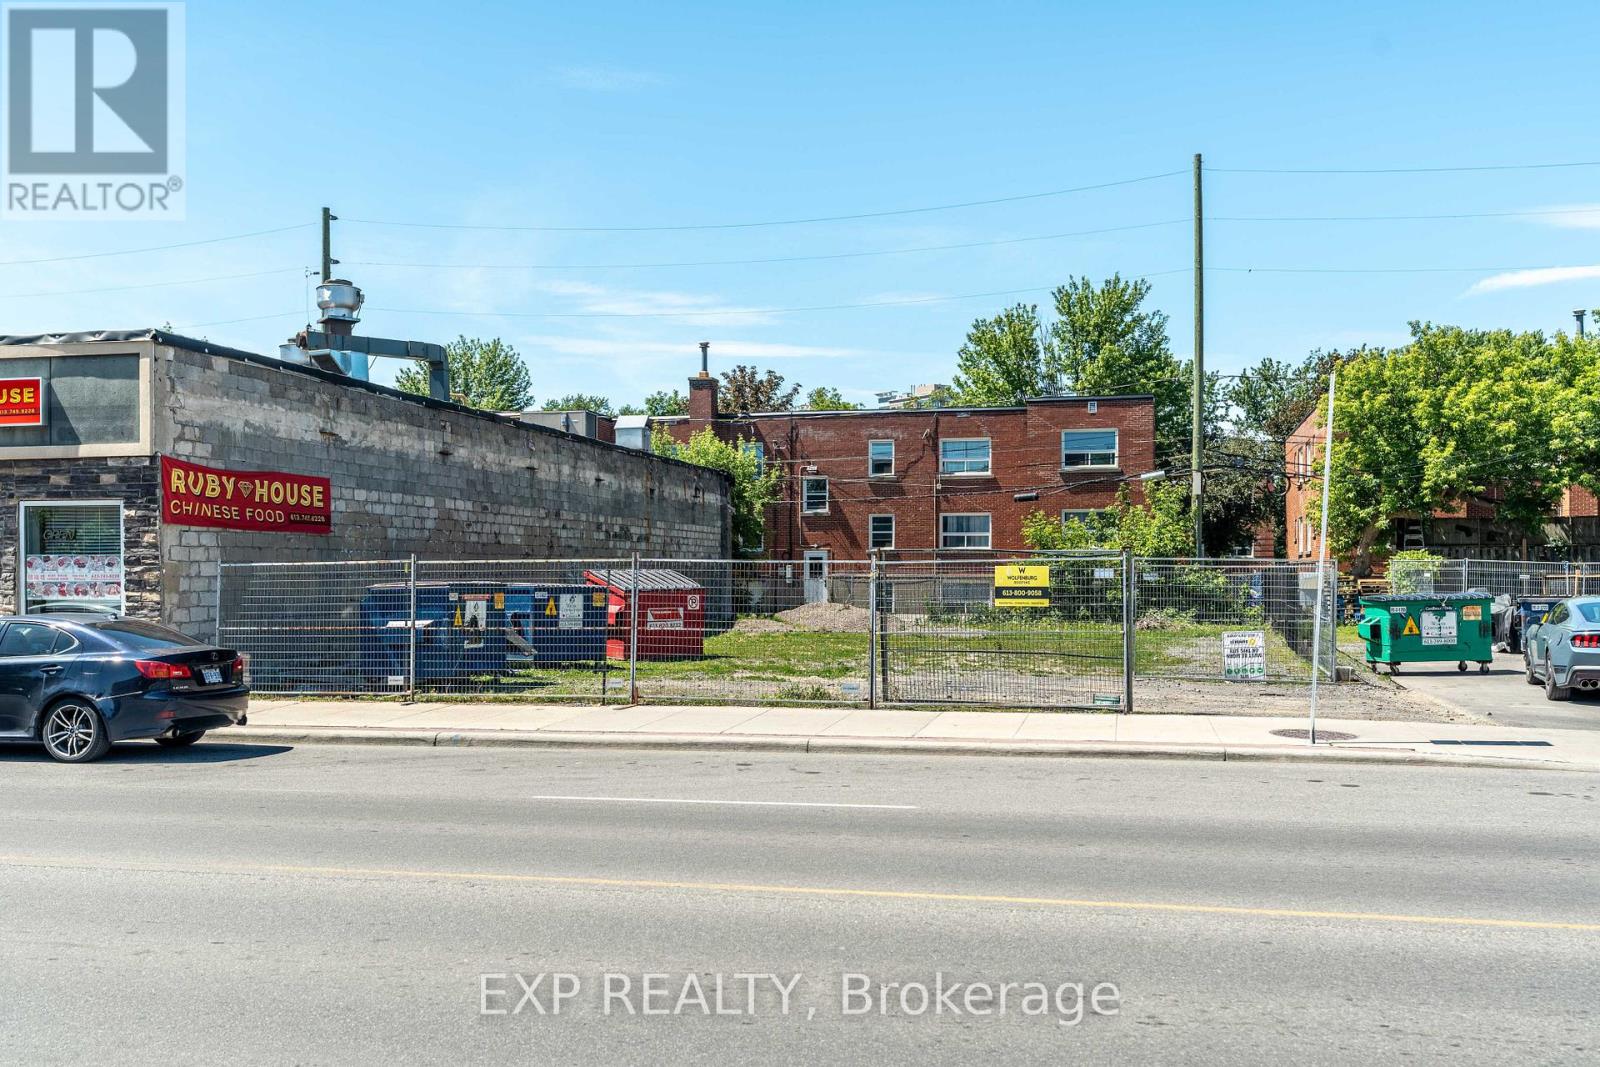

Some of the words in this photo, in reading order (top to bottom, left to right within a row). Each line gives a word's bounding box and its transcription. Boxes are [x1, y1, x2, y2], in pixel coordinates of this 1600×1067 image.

[171, 468, 236, 500] RUBY
[254, 479, 324, 508] HOUSE
[170, 500, 240, 520] CHINESE
[245, 508, 285, 523] FOOD
